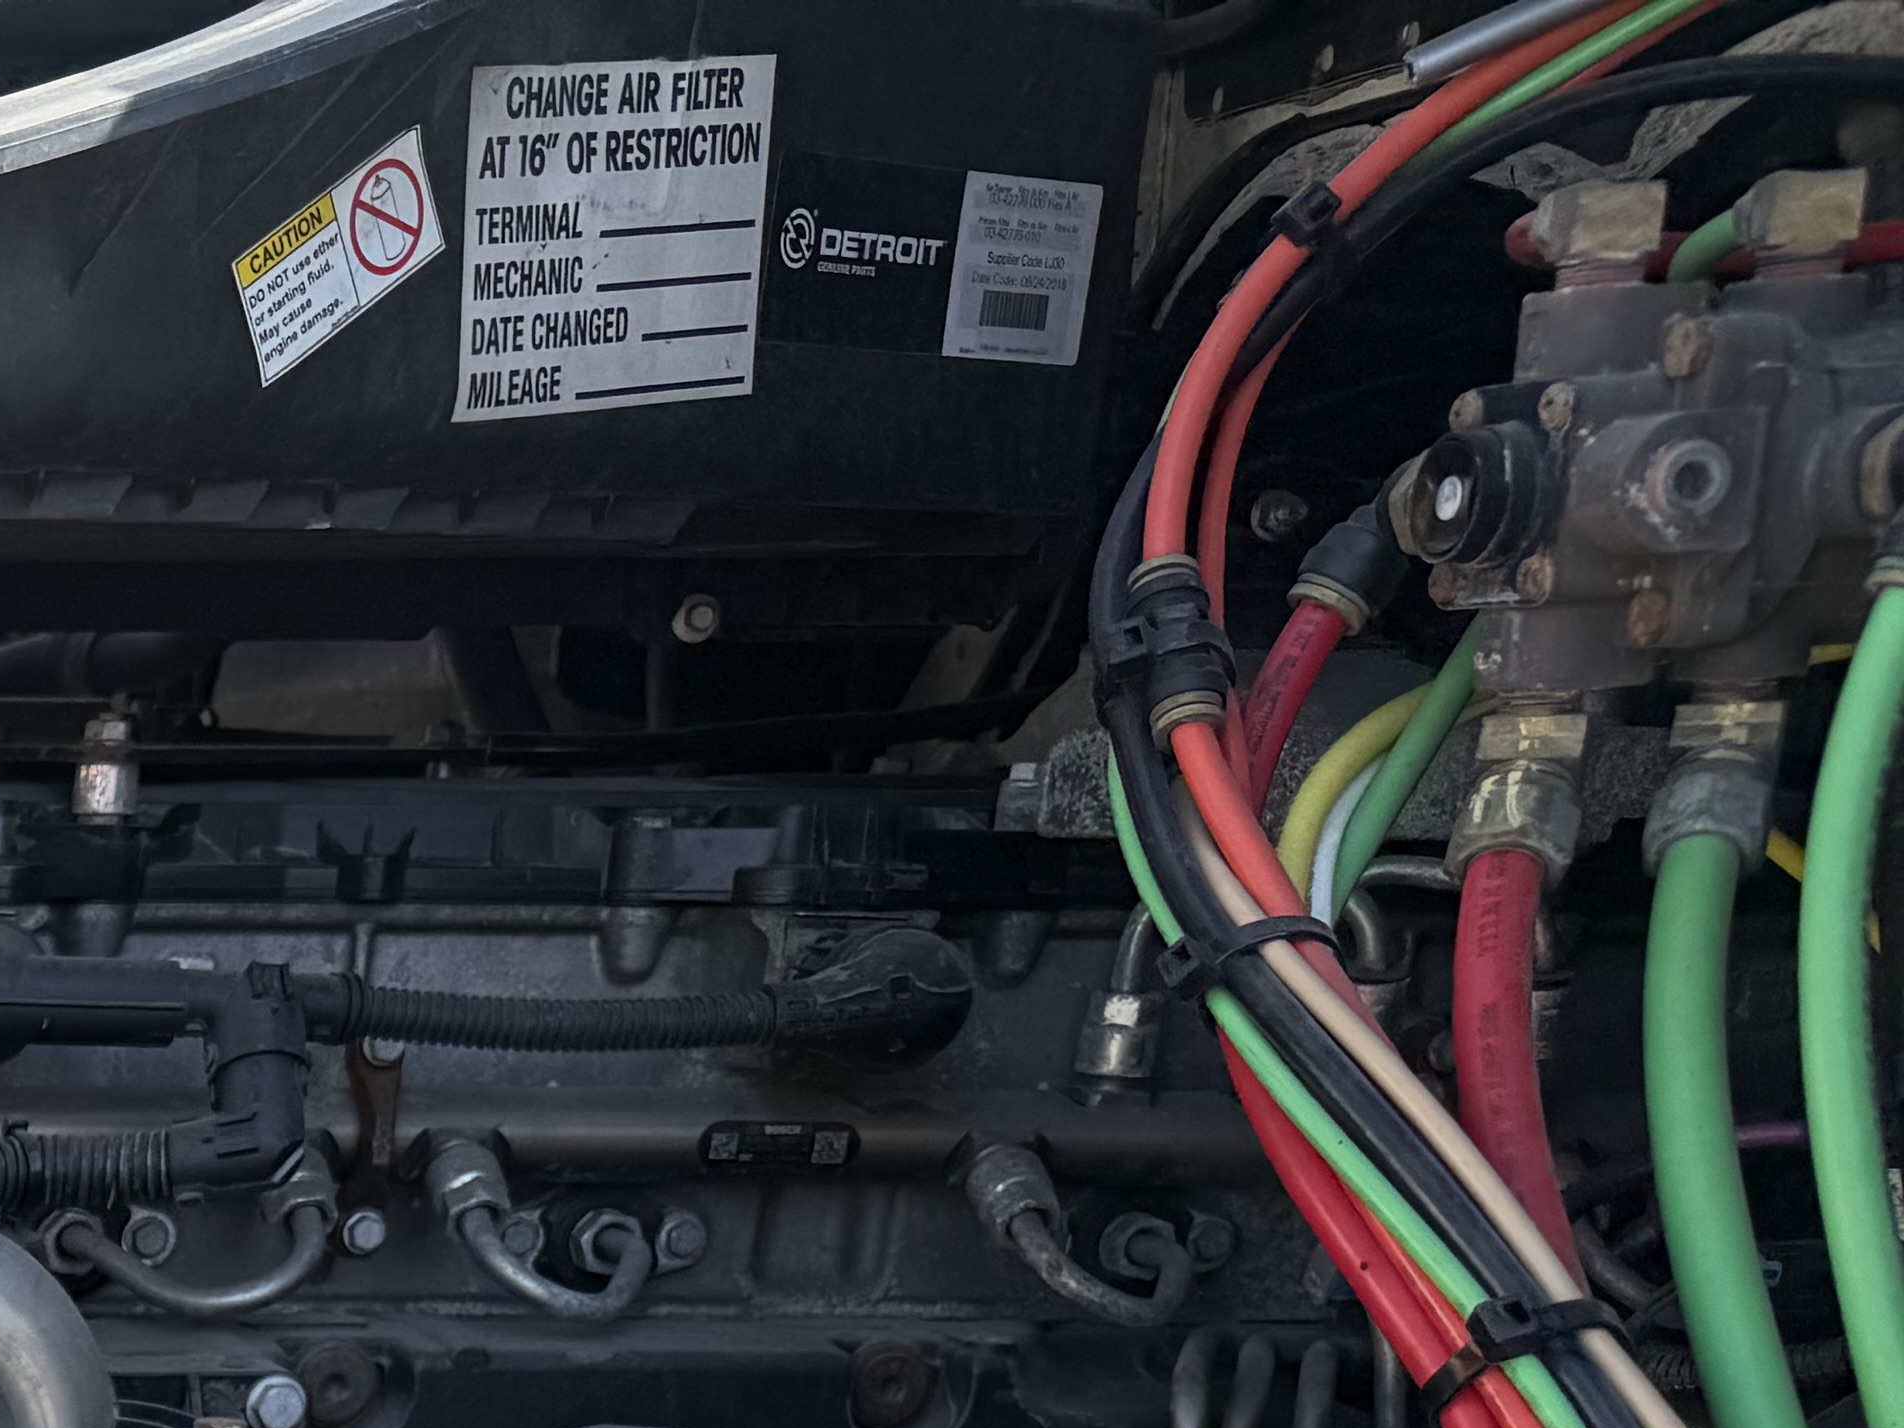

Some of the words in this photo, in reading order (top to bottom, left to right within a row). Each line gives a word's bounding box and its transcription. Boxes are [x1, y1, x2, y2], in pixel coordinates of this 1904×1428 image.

[506, 73, 610, 119] CHANGE
[618, 71, 660, 114] AIR
[671, 67, 744, 112] FILTER
[479, 136, 510, 179] AT
[519, 132, 559, 177] 16"
[567, 132, 597, 174] OF
[606, 122, 761, 172] RESTRICTION
[249, 207, 322, 275] CAUTION
[475, 202, 583, 245] TERMINAL
[820, 228, 944, 266] DETROIT
[249, 293, 265, 309] DO
[267, 272, 289, 293] NOT
[293, 255, 311, 276] use
[312, 232, 339, 262] ether
[473, 257, 583, 301] MECHANIC
[1021, 254, 1043, 267] Code
[255, 313, 266, 327] or
[267, 280, 307, 318] starting
[307, 263, 335, 286] fluid.
[260, 328, 280, 346] May
[282, 298, 313, 327] cause
[264, 331, 299, 363] engine
[300, 298, 343, 341] damage.
[471, 314, 524, 356] DATE
[532, 307, 628, 351] CHANGED
[467, 366, 562, 410] MILEAGE
